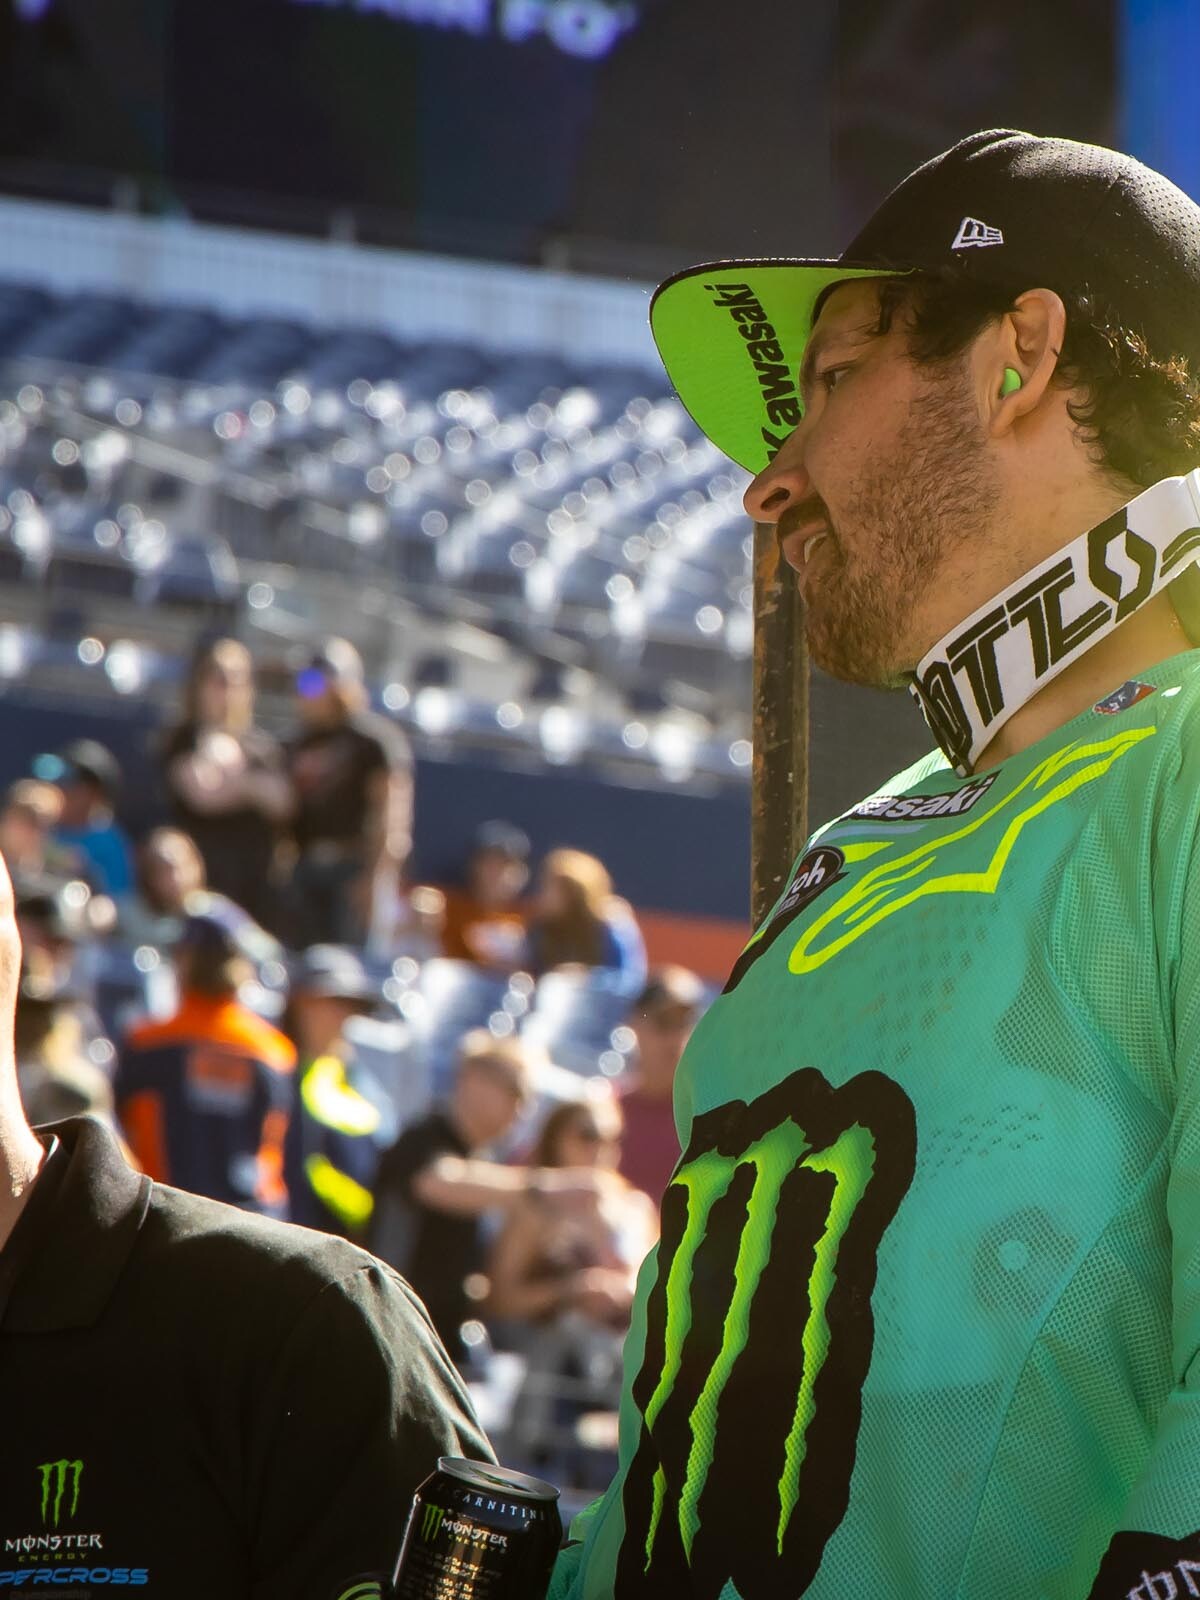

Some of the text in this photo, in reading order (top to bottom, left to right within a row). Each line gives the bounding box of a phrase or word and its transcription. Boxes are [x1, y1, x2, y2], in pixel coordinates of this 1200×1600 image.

[5, 1534, 103, 1552] MONSTER
[18, 1553, 89, 1563] ENERGY
[0, 1567, 149, 1586] PERCROSS
